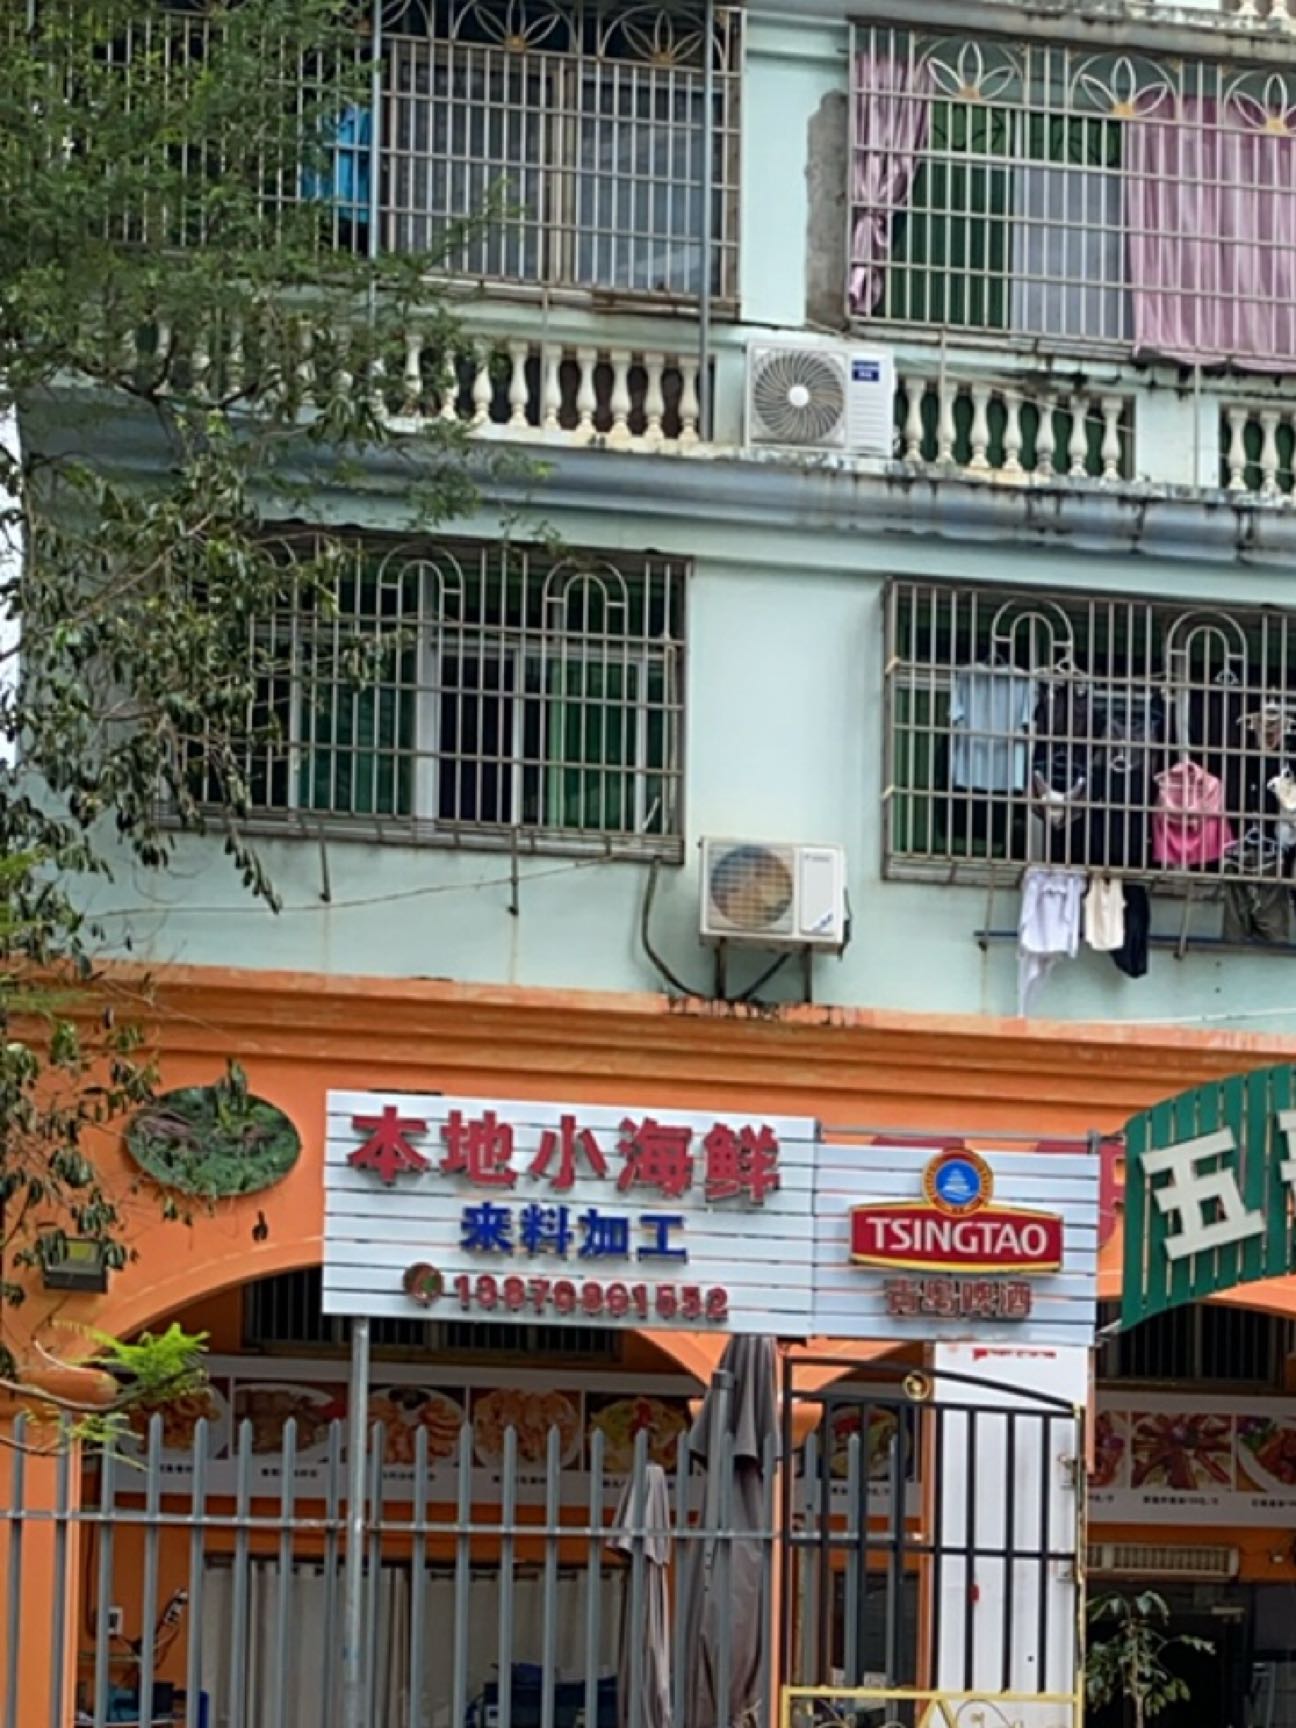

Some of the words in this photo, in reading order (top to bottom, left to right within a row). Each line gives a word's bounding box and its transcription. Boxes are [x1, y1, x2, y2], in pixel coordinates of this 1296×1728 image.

[347, 1104, 781, 1206] 本地小海鲜
[460, 1200, 688, 1263] 来料加工
[866, 1216, 1048, 1256] TSINGTAO
